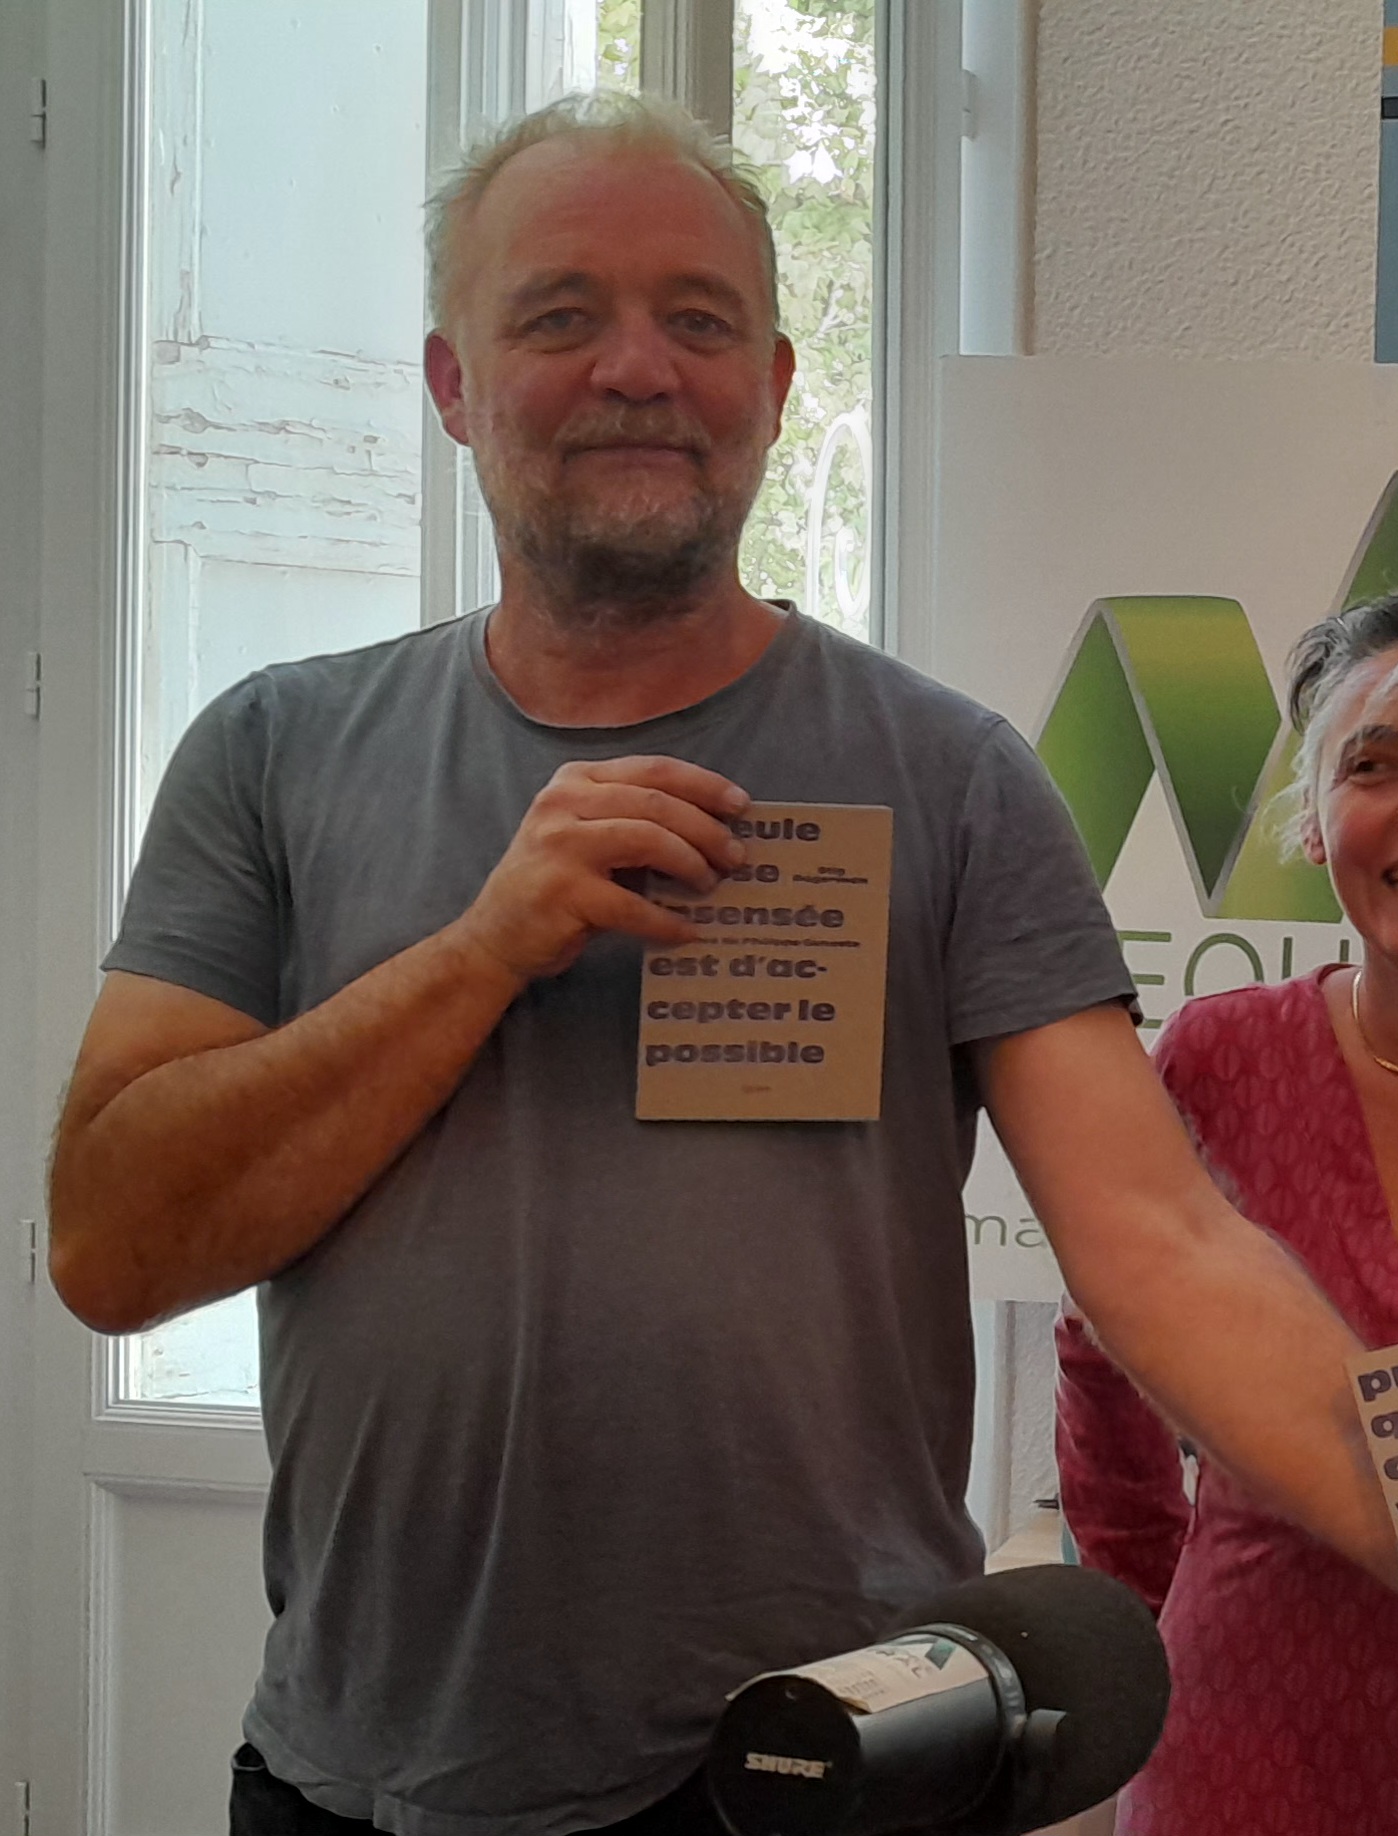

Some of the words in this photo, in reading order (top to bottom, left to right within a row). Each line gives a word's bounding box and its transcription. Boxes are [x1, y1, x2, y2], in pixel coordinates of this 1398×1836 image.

[733, 818, 821, 841] eule
[648, 954, 721, 977] est
[646, 998, 792, 1024] cepter
[797, 1000, 836, 1022] le
[645, 1040, 826, 1067] possible
[744, 1752, 826, 1779] SHURE
